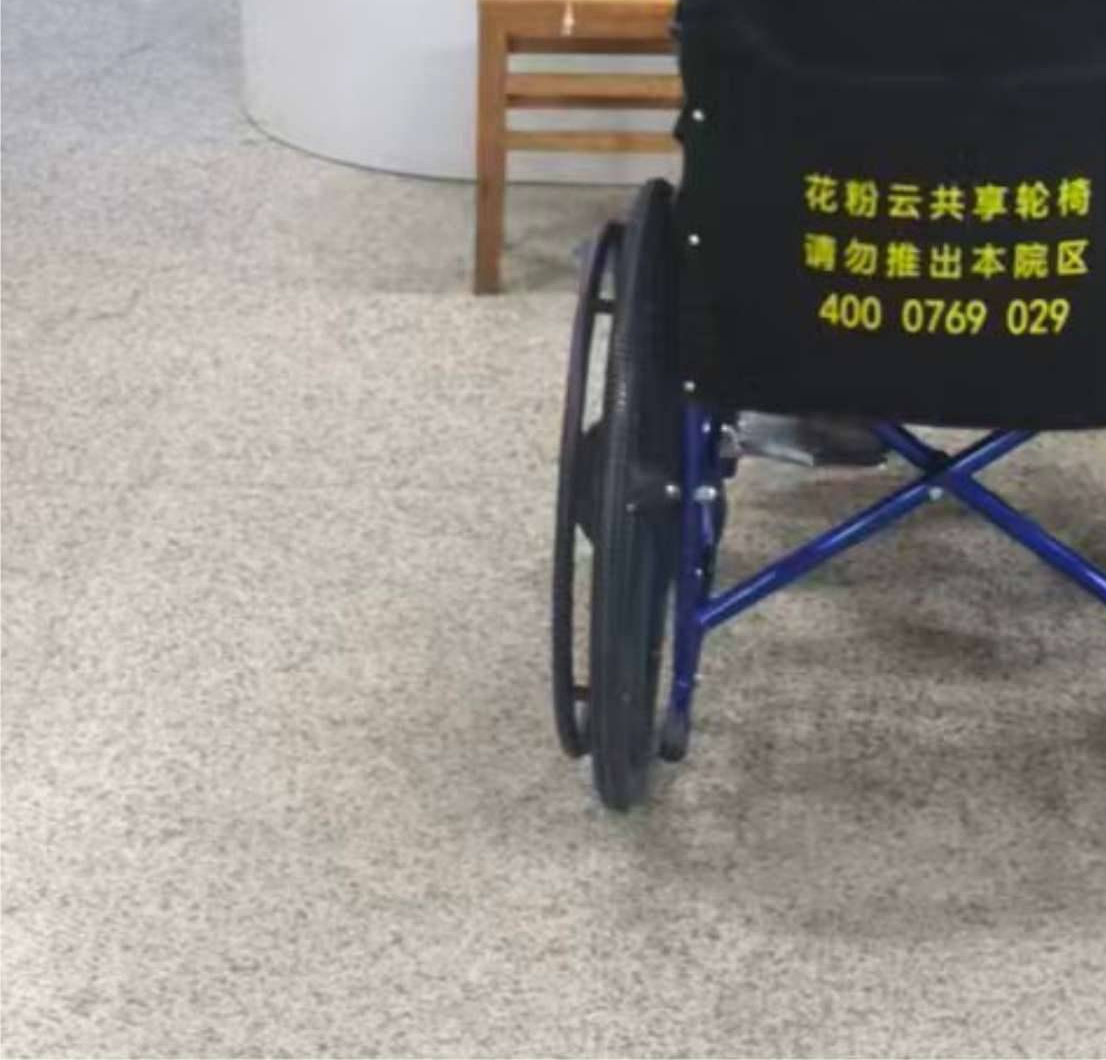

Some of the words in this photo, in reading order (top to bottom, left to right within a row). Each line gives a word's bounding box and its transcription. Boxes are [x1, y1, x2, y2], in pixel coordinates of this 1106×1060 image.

[804, 172, 1092, 221] 花粉云共享轮椅
[804, 233, 1090, 280] 请勿推出本院区
[818, 293, 882, 331] 400
[902, 298, 987, 334] 0769
[1006, 298, 1070, 335] 029
